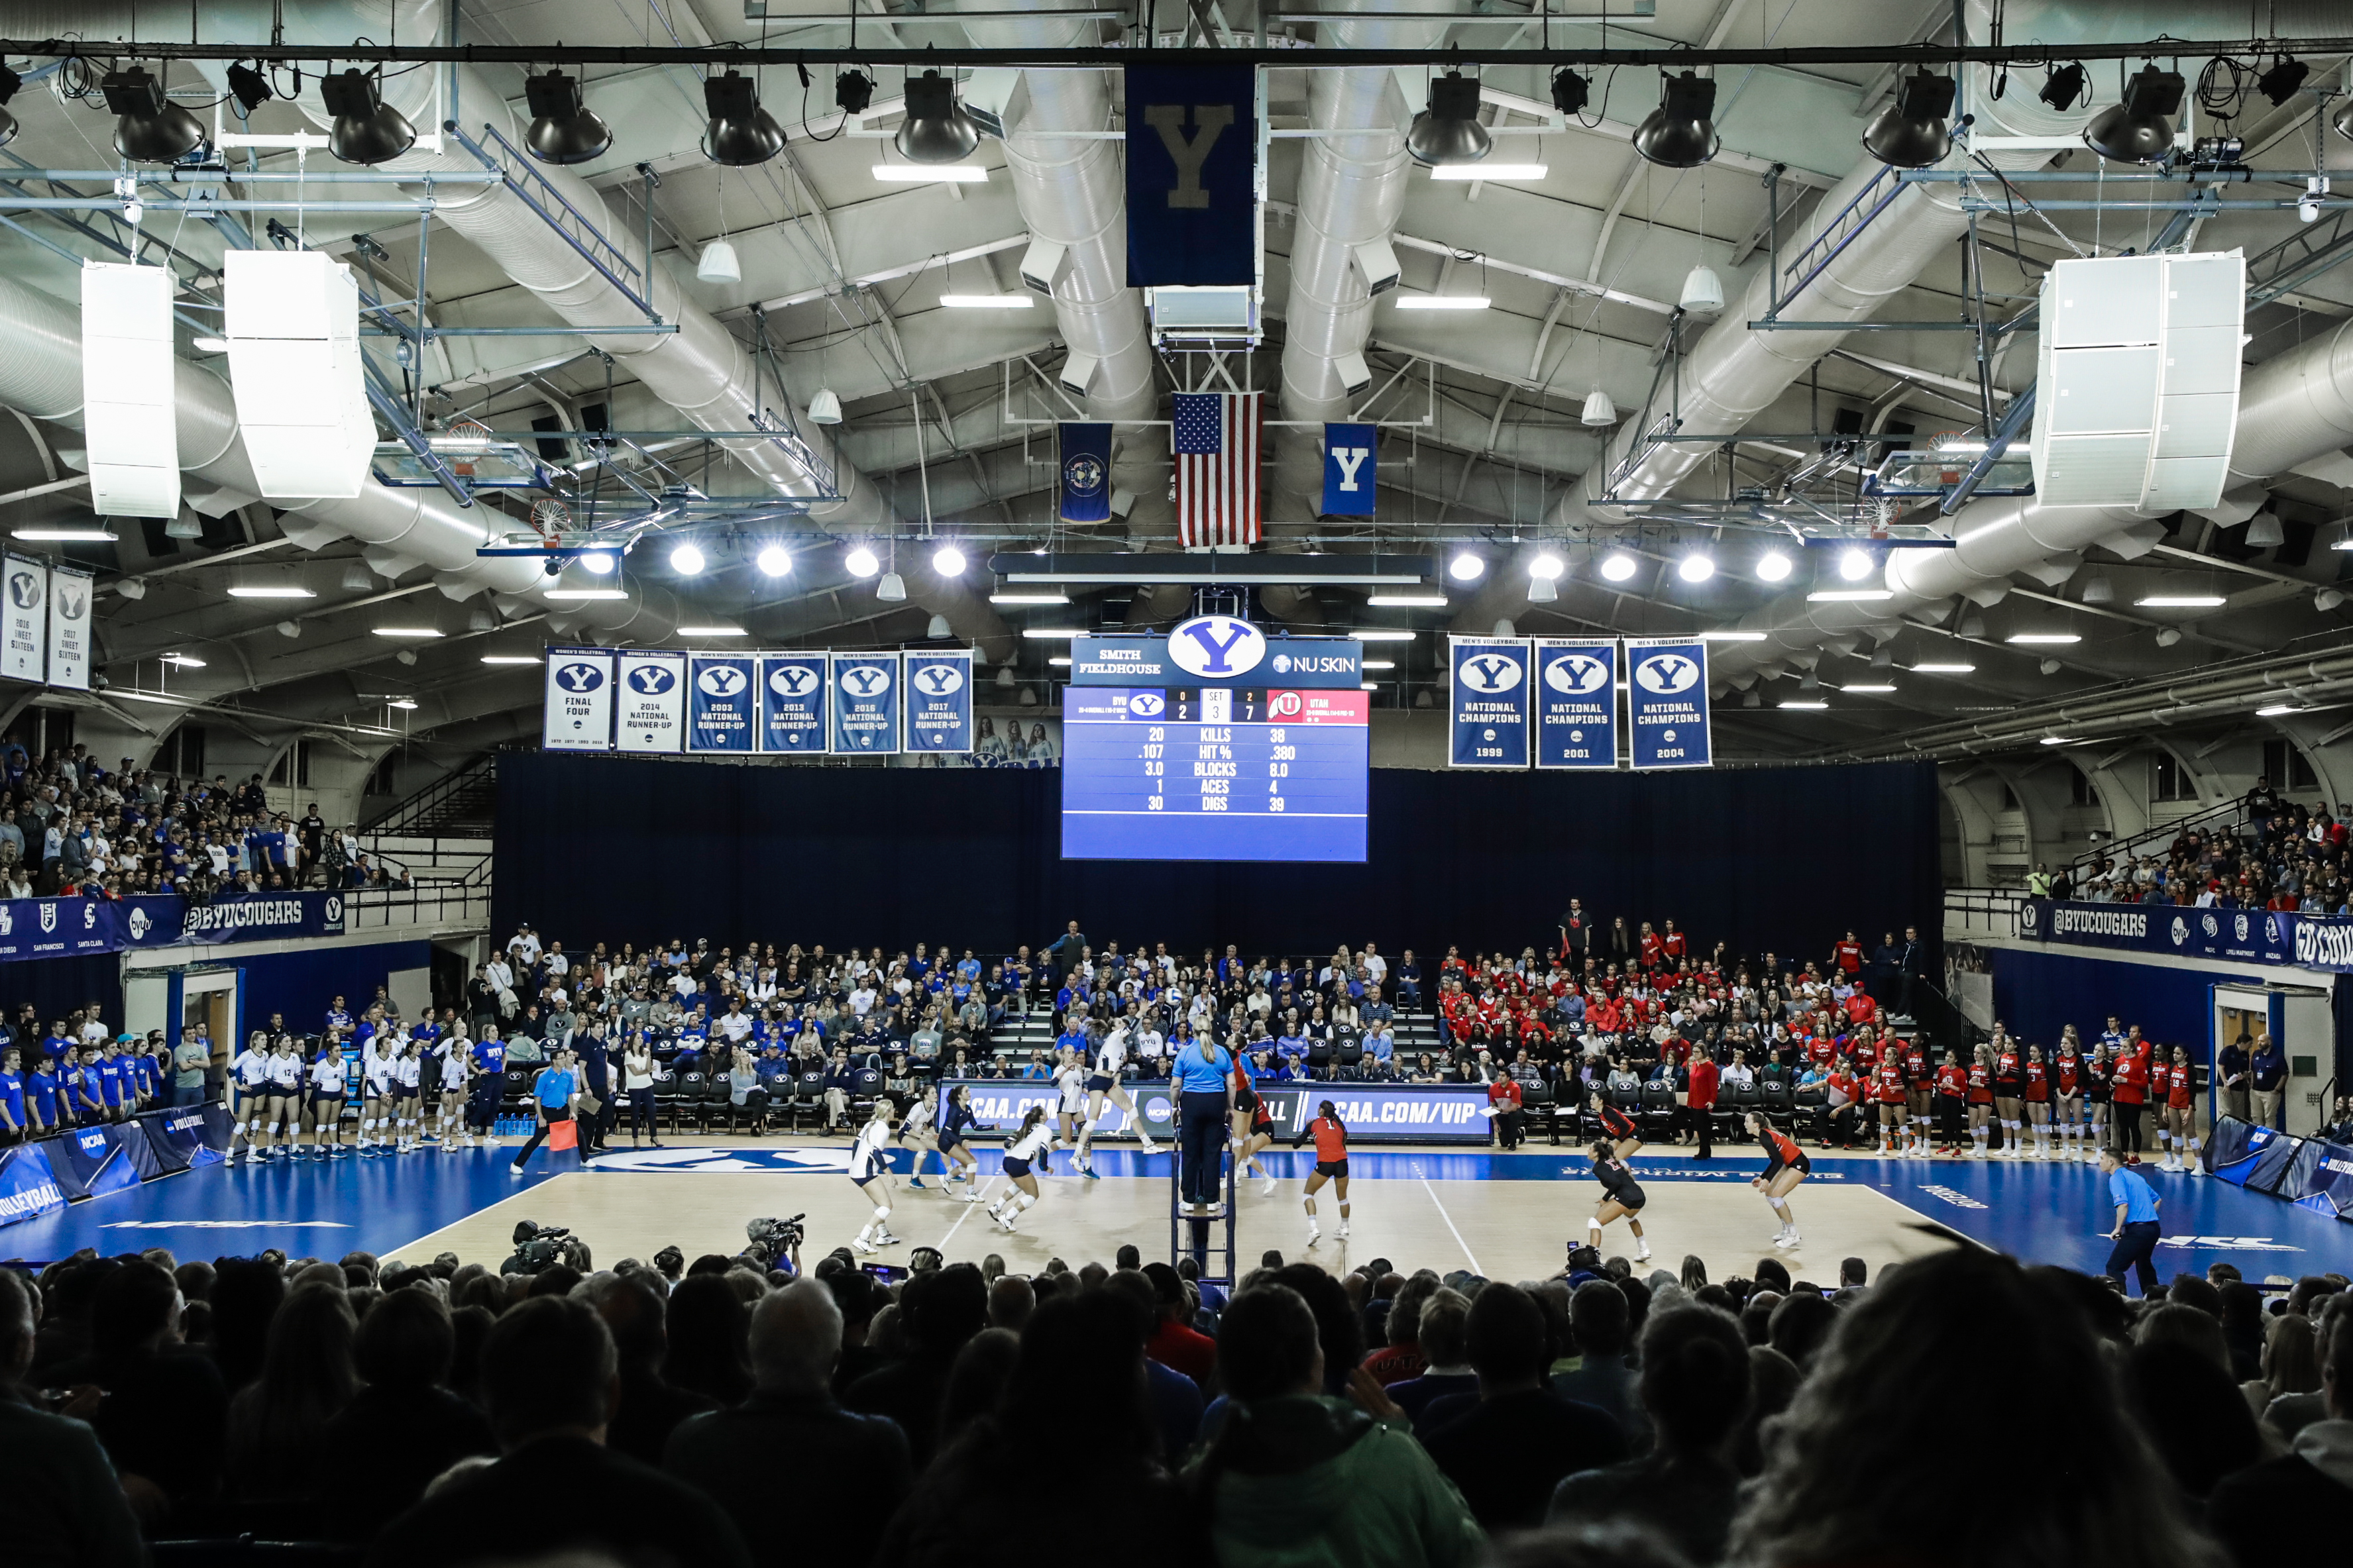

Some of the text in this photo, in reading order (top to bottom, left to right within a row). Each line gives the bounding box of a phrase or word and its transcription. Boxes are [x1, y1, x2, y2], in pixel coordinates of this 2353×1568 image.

[1144, 105, 1234, 208] Y
[1332, 448, 1368, 492] Y
[15, 576, 36, 606] Y
[16, 619, 29, 629] 2016
[15, 629, 31, 640] SWEET
[64, 629, 76, 639] 2017
[11, 641, 34, 652] SIXTEEN
[62, 640, 78, 650] SWEET
[1182, 621, 1252, 672] Y
[58, 651, 80, 661] SIXTEEN
[1099, 649, 1141, 660] SMITH
[1079, 664, 1161, 674] FIELDHOUSE
[1294, 657, 1355, 672] NU SKIN
[563, 666, 596, 690] Y
[635, 668, 668, 692] Y
[706, 669, 738, 693] Y
[779, 669, 810, 693] Y
[922, 668, 954, 692] Y
[1470, 658, 1511, 689] Y
[1556, 659, 1597, 690] Y
[1647, 659, 1687, 689] Y
[849, 670, 881, 694] Y
[565, 698, 592, 706] FINAL
[1113, 696, 1127, 706] BYU
[1179, 692, 1185, 700] 0
[1209, 692, 1223, 701] SET
[1247, 692, 1252, 702] 2
[1309, 699, 1329, 708] UTAH
[1136, 697, 1158, 713] Y
[1179, 705, 1186, 719] 2
[1213, 706, 1219, 718] 3
[1282, 697, 1297, 712] U
[1465, 702, 1515, 712] NATIONAL
[1551, 704, 1602, 713] NATIONAL
[1643, 703, 1694, 713] NATIONAL
[1246, 706, 1254, 720] 7
[1459, 713, 1521, 723] CHAMPIONS
[1545, 714, 1608, 725] CHAMPIONS
[1637, 713, 1701, 725] CHAMPIONS
[1149, 727, 1164, 742] 20
[1200, 727, 1231, 742] KILLS
[1270, 728, 1286, 743] 38
[1138, 744, 1164, 758] .107
[1199, 745, 1232, 759] HIT %
[1270, 745, 1295, 760] .380
[1476, 747, 1503, 757] 1999
[1563, 749, 1590, 758] 2001
[1657, 748, 1684, 758] 2004
[1145, 761, 1164, 776] 3.0
[1194, 762, 1236, 776] BLOCKS
[1269, 762, 1288, 778] 8.0
[1156, 778, 1162, 793] 1
[1200, 779, 1230, 794] ACES
[1269, 780, 1278, 794] 4
[1148, 796, 1164, 811] 30
[1202, 796, 1228, 811] DIGS
[1269, 797, 1284, 812] 39
[328, 898, 339, 919] Y
[2025, 907, 2034, 925] Y
[2054, 909, 2147, 937] @BYUCOUGARS
[2295, 921, 2315, 961] GO
[486, 1048, 502, 1057] BYU
[1073, 1079, 1080, 1088] 14
[1148, 1108, 1171, 1117] NCAA
[1336, 1101, 1476, 1124] CAA.COM/VIP
[174, 1114, 205, 1131] VOLLEYBALL
[80, 1134, 106, 1149] NCAA
